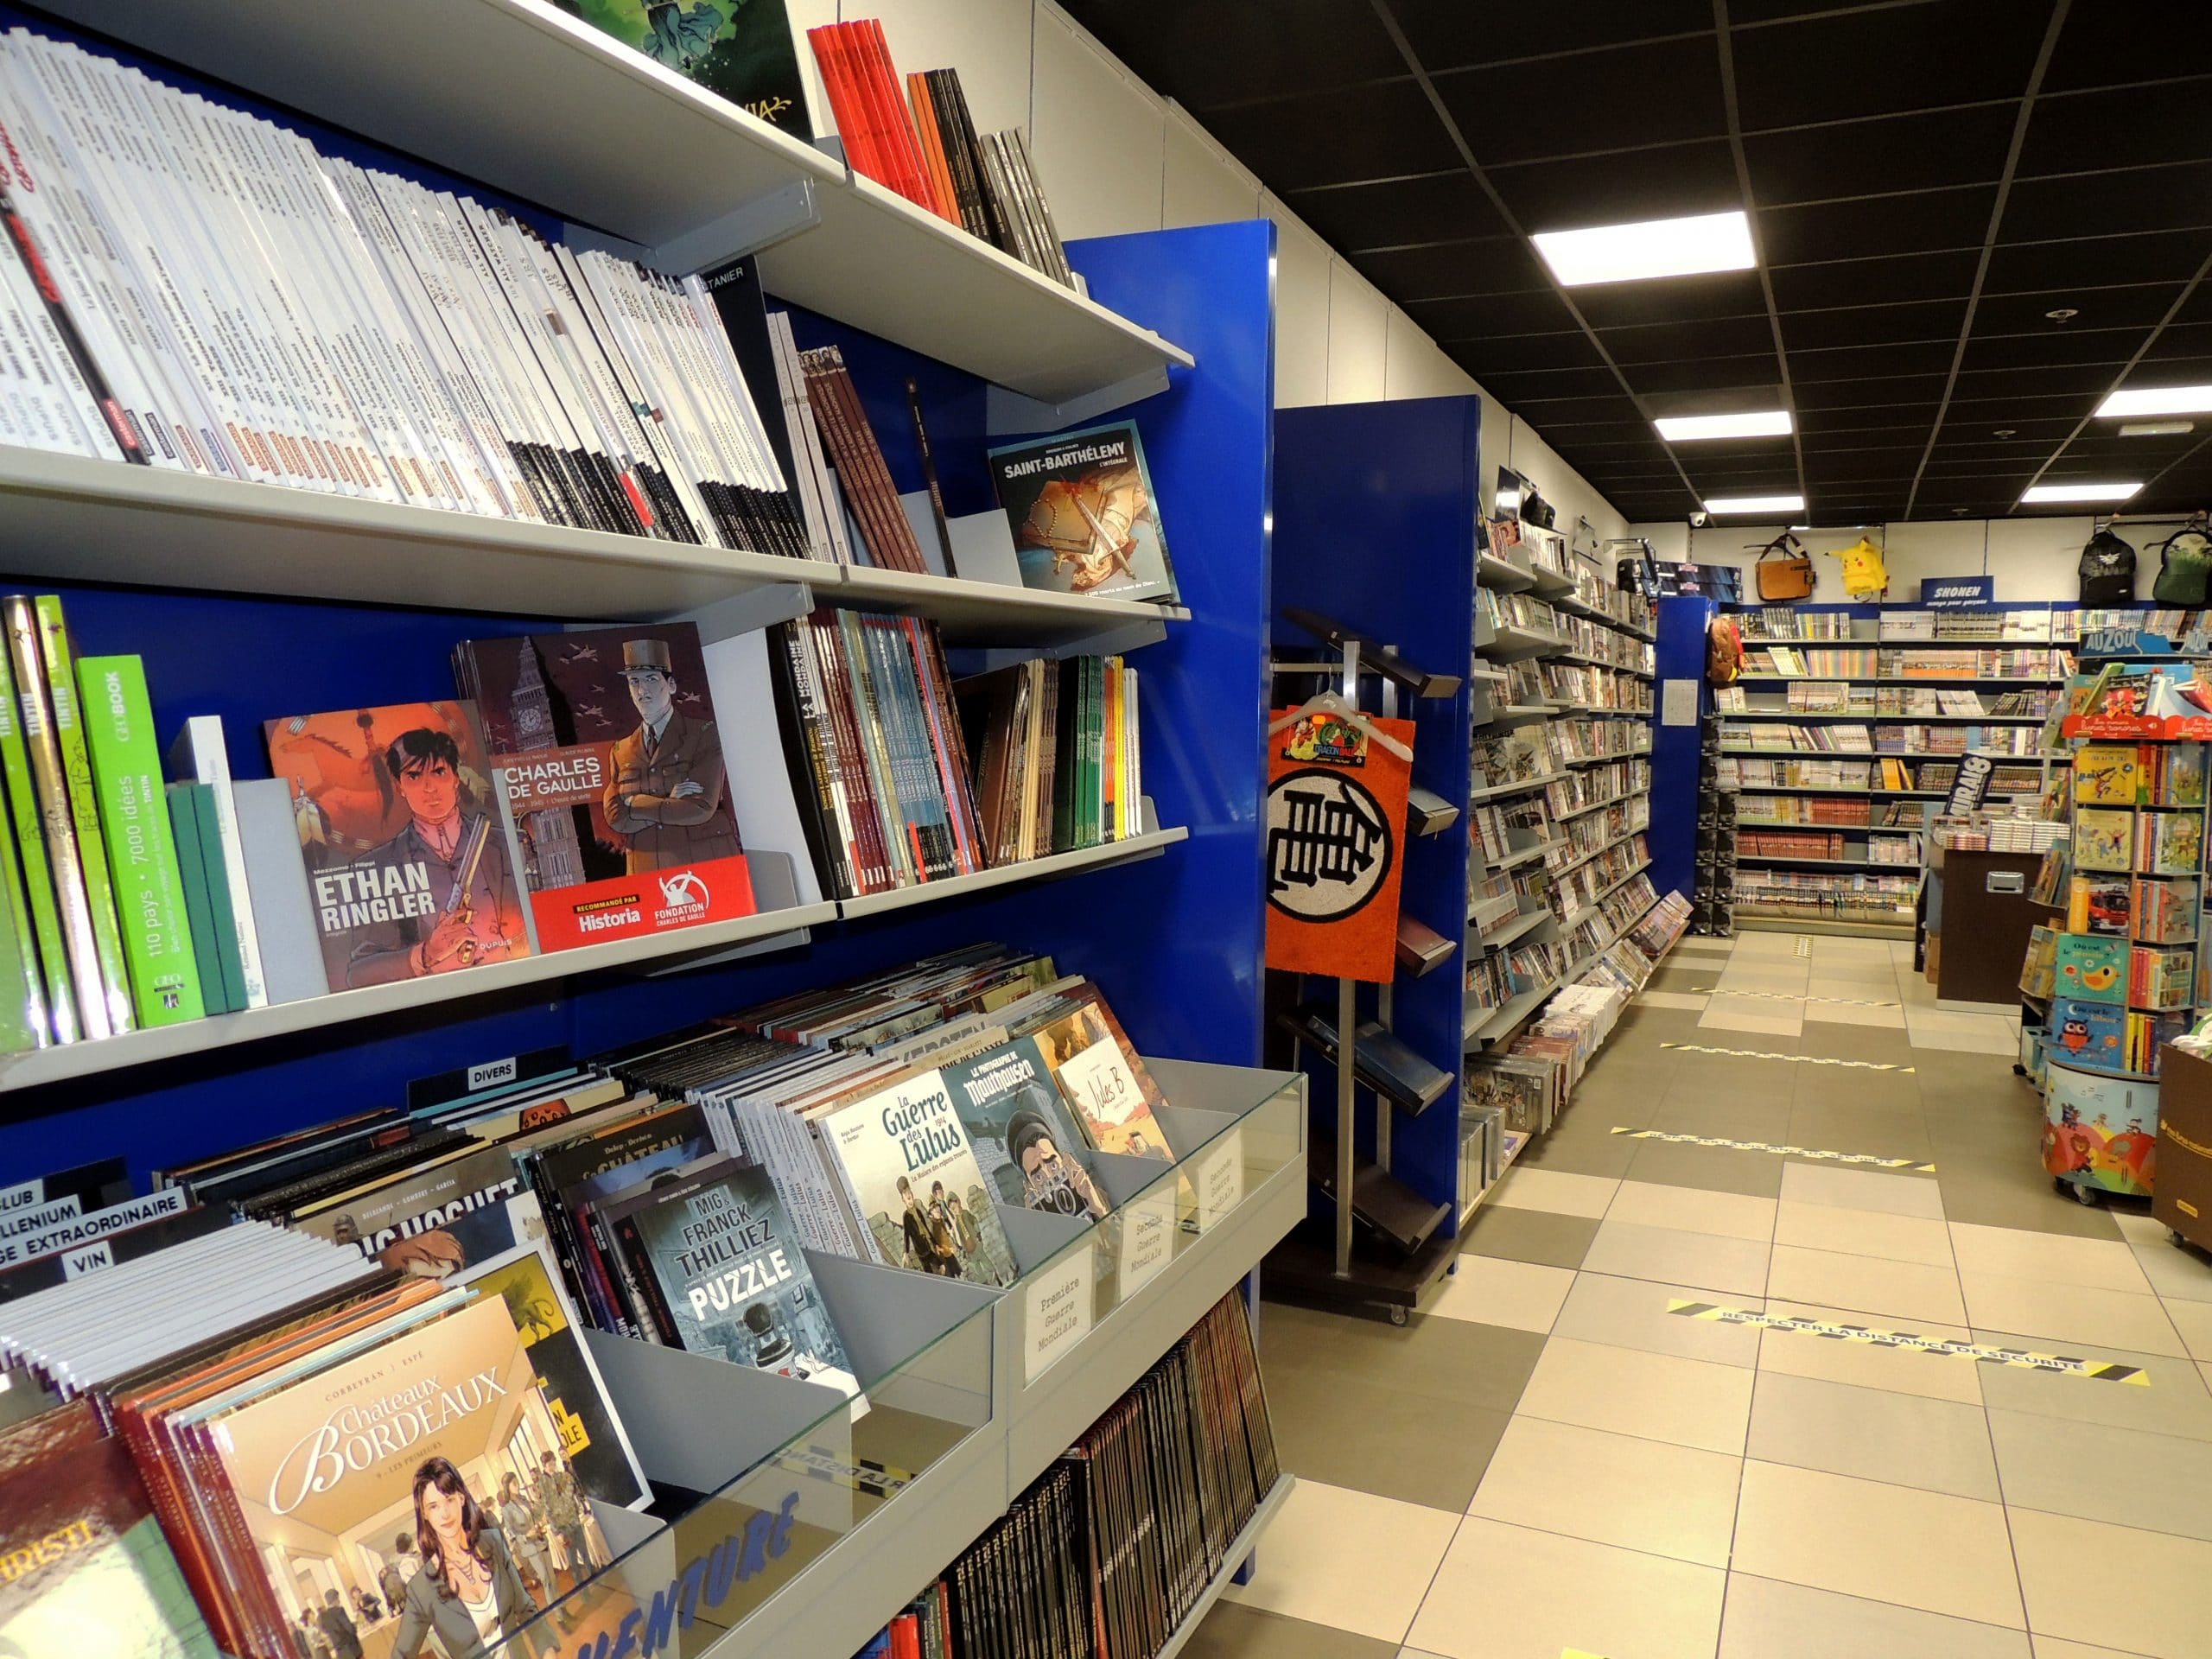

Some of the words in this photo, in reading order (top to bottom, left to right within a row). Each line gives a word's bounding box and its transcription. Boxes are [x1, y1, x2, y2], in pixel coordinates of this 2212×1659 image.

[86, 404, 115, 449] DUPUIS
[105, 398, 134, 448] casterman
[125, 408, 153, 457] casterman
[146, 411, 174, 459] casterman
[227, 423, 252, 465] DARGAUD
[242, 428, 267, 469] DARGAUD
[255, 433, 279, 474] DARGAUD
[269, 431, 294, 473] DARGAUD
[288, 436, 313, 478] DARGAUD
[302, 435, 326, 476] DARGAUD
[324, 440, 348, 480] DARGAUD
[1004, 442, 1125, 479] SAINT-BARTHÉLEMY
[788, 639, 806, 697] MONDAINE
[22, 693, 41, 736] TINTIN
[54, 687, 73, 729] TINTIN
[801, 702, 810, 719] LA
[505, 757, 601, 784] CHARLES
[1314, 745, 1338, 756] DRAGON
[119, 775, 139, 823] idées
[142, 774, 153, 803] TINTIN
[508, 784, 531, 799] DE
[537, 774, 603, 795] GAULLE
[123, 825, 146, 865] 7000
[314, 866, 349, 875] Mezzomo
[315, 861, 430, 907] ETHAN
[140, 889, 162, 930] pays
[321, 892, 436, 932] RINGLER
[576, 899, 623, 912] RECOMMANDÉ
[579, 908, 641, 932] Historia
[654, 902, 704, 920] FONDATION
[656, 917, 678, 927] CHARLES
[687, 911, 705, 922] GAULLE
[147, 936, 163, 958] 110
[480, 939, 512, 950] DUPUIS
[474, 1065, 512, 1083] DIVERS
[963, 1058, 1035, 1108] Mauthausen
[1087, 1077, 1116, 1119] Jules
[1109, 1066, 1124, 1094] B
[882, 1091, 947, 1137] Guerre
[898, 1096, 909, 1109] La
[899, 1123, 961, 1172] Lulus
[906, 1128, 922, 1143] des
[683, 1203, 752, 1247] FRANCK
[696, 1193, 723, 1217] MIG
[26, 1197, 178, 1255] EXTRAORDINAIRE
[73, 1250, 106, 1273] VIN
[676, 1219, 776, 1277] THILLIEZ
[689, 1249, 792, 1321] PUZZLE
[1041, 1278, 1079, 1312] Première
[1038, 1317, 1077, 1352] Mondiale
[1045, 1300, 1075, 1328] Guerre
[1721, 1311, 1826, 1334] RESPECTER
[1827, 1323, 1851, 1337] LA
[1856, 1330, 1951, 1351] DISTANCE
[1955, 1344, 1981, 1357] DE
[325, 1370, 385, 1402] CORBEYRAN
[402, 1351, 425, 1368] ESPÉ
[340, 1375, 443, 1435] Châteaux
[269, 1366, 507, 1516] BORDEAUX
